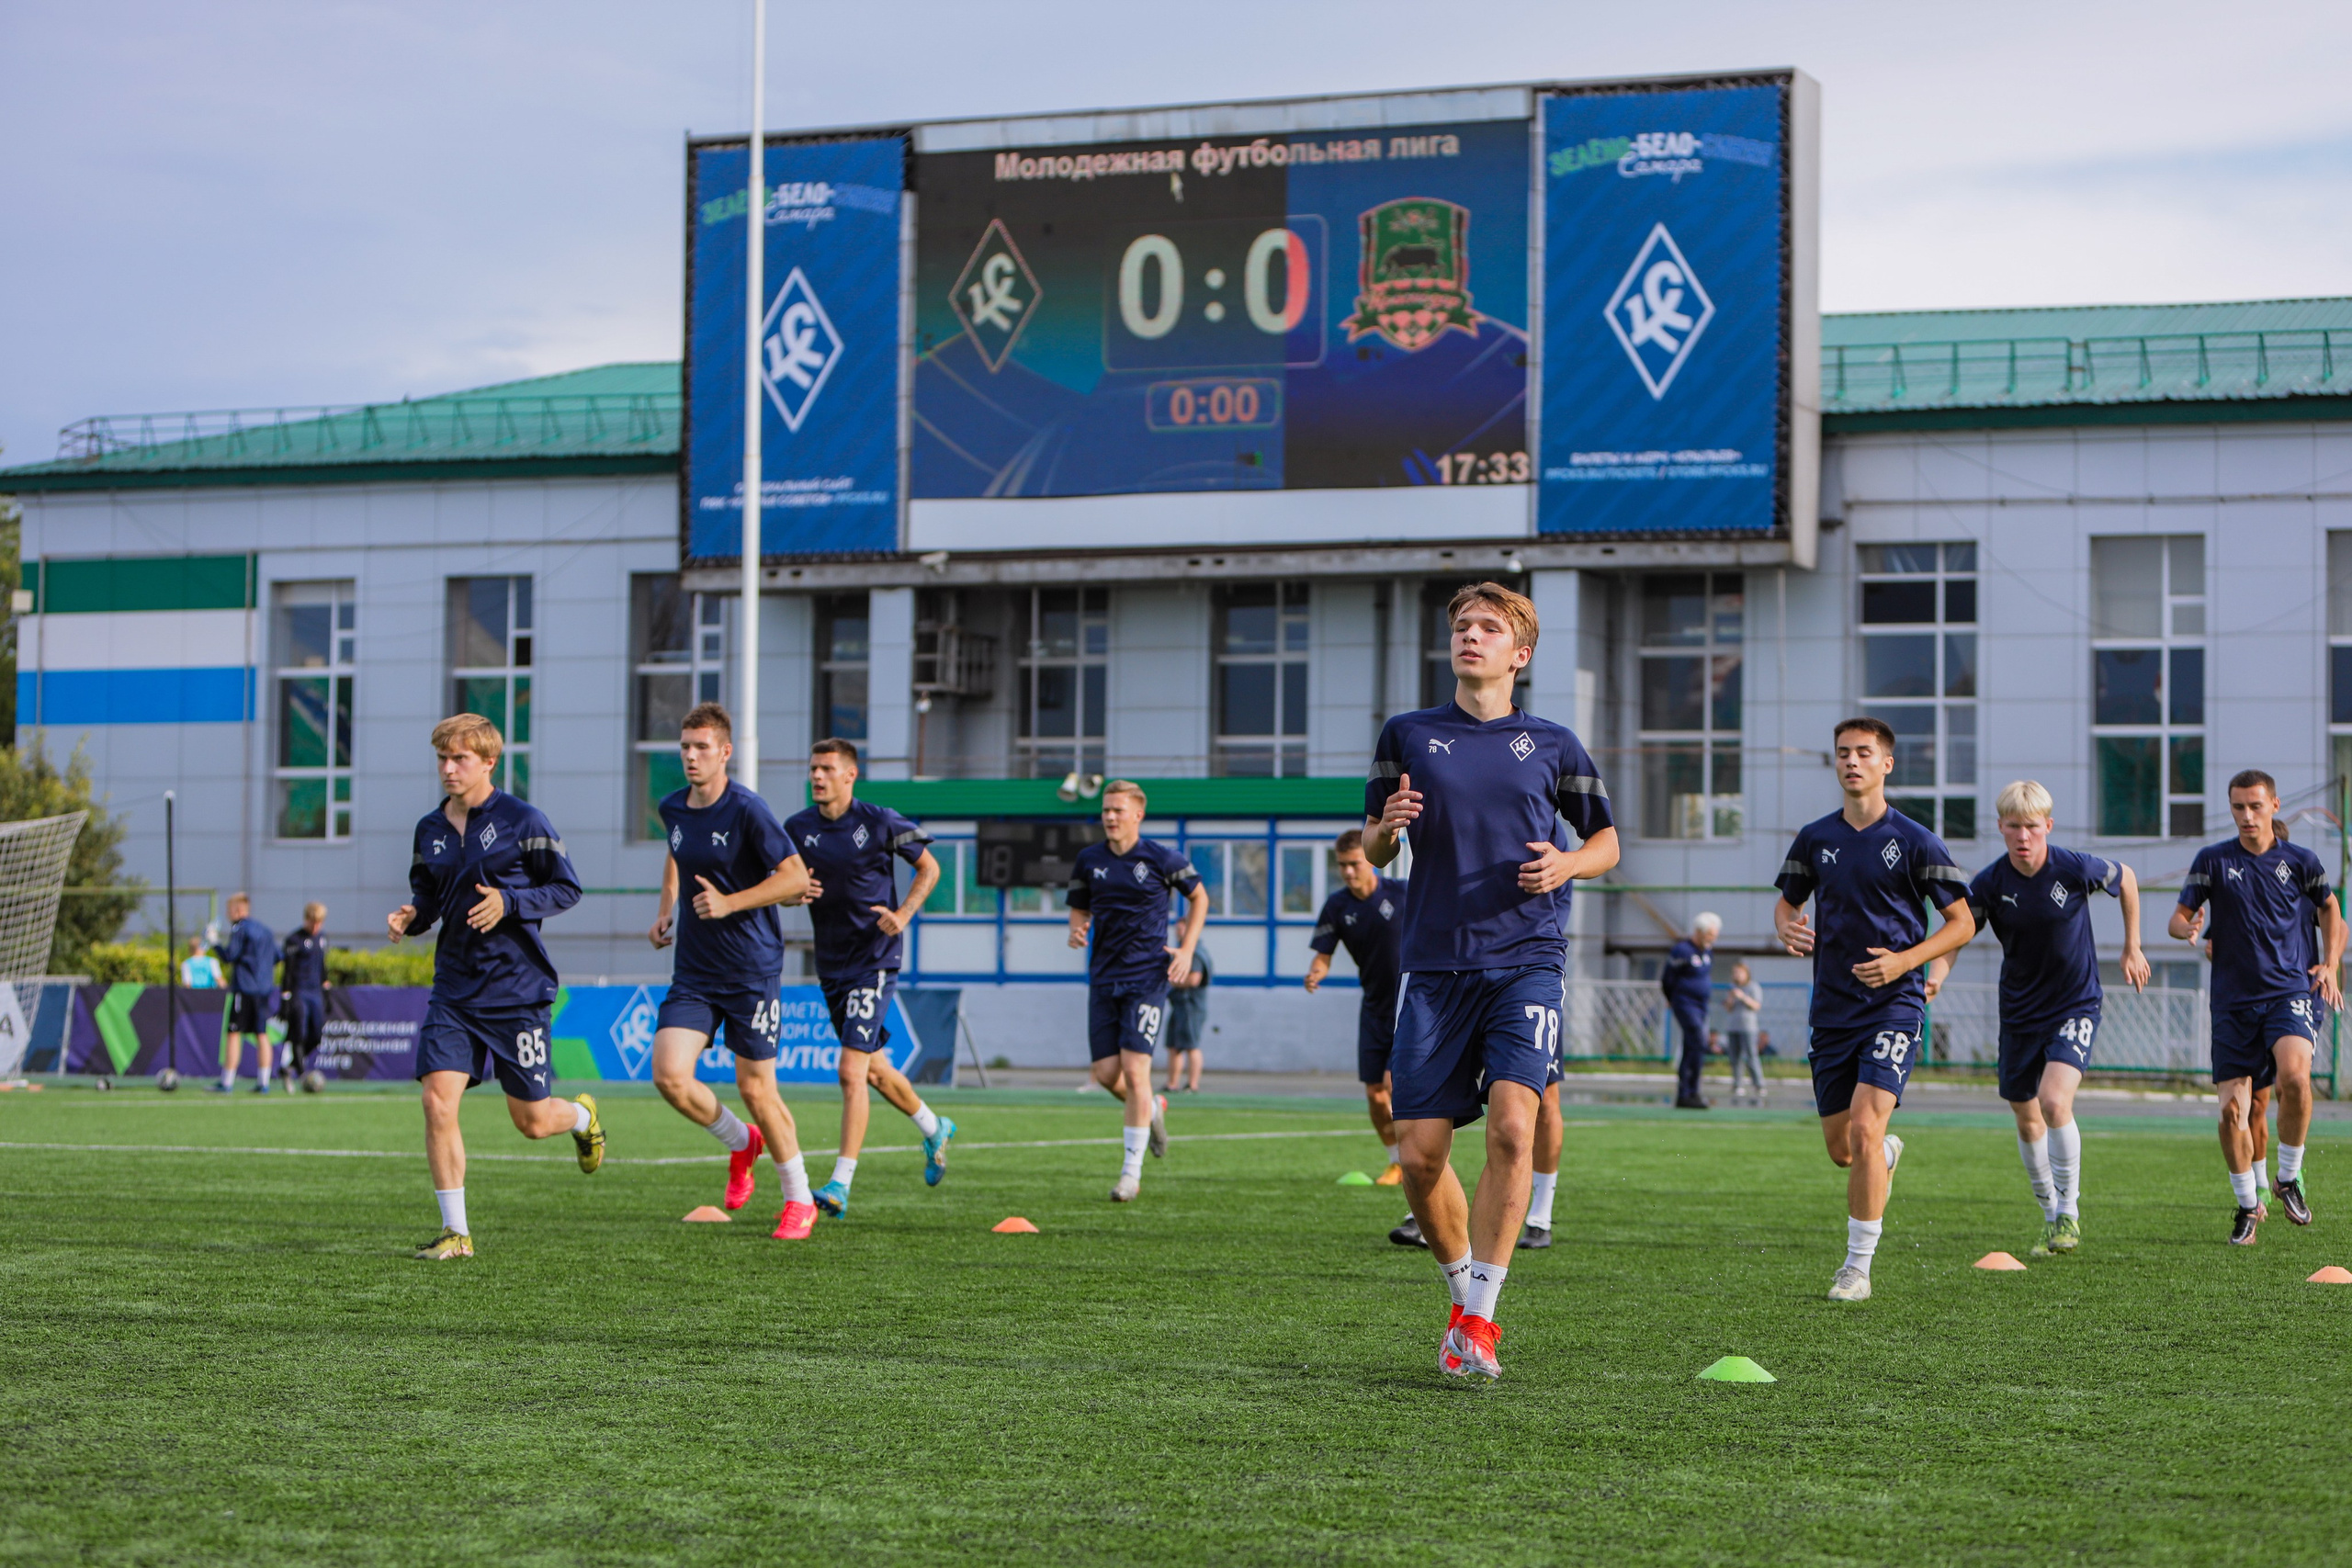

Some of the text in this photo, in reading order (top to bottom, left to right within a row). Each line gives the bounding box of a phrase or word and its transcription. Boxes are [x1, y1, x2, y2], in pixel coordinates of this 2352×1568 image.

[994, 134, 1462, 182] Молодежная футбольная лига
[1170, 385, 1261, 425] 0:00
[1435, 451, 1530, 485] 17:33
[1428, 745, 1438, 754] 78
[751, 998, 780, 1035] 49
[845, 987, 876, 1021] 63
[1136, 1003, 1161, 1036] 79
[515, 1028, 546, 1069] 85
[1522, 1005, 1560, 1057] 78
[1871, 1030, 1909, 1066] 58
[2059, 1017, 2093, 1048] 48
